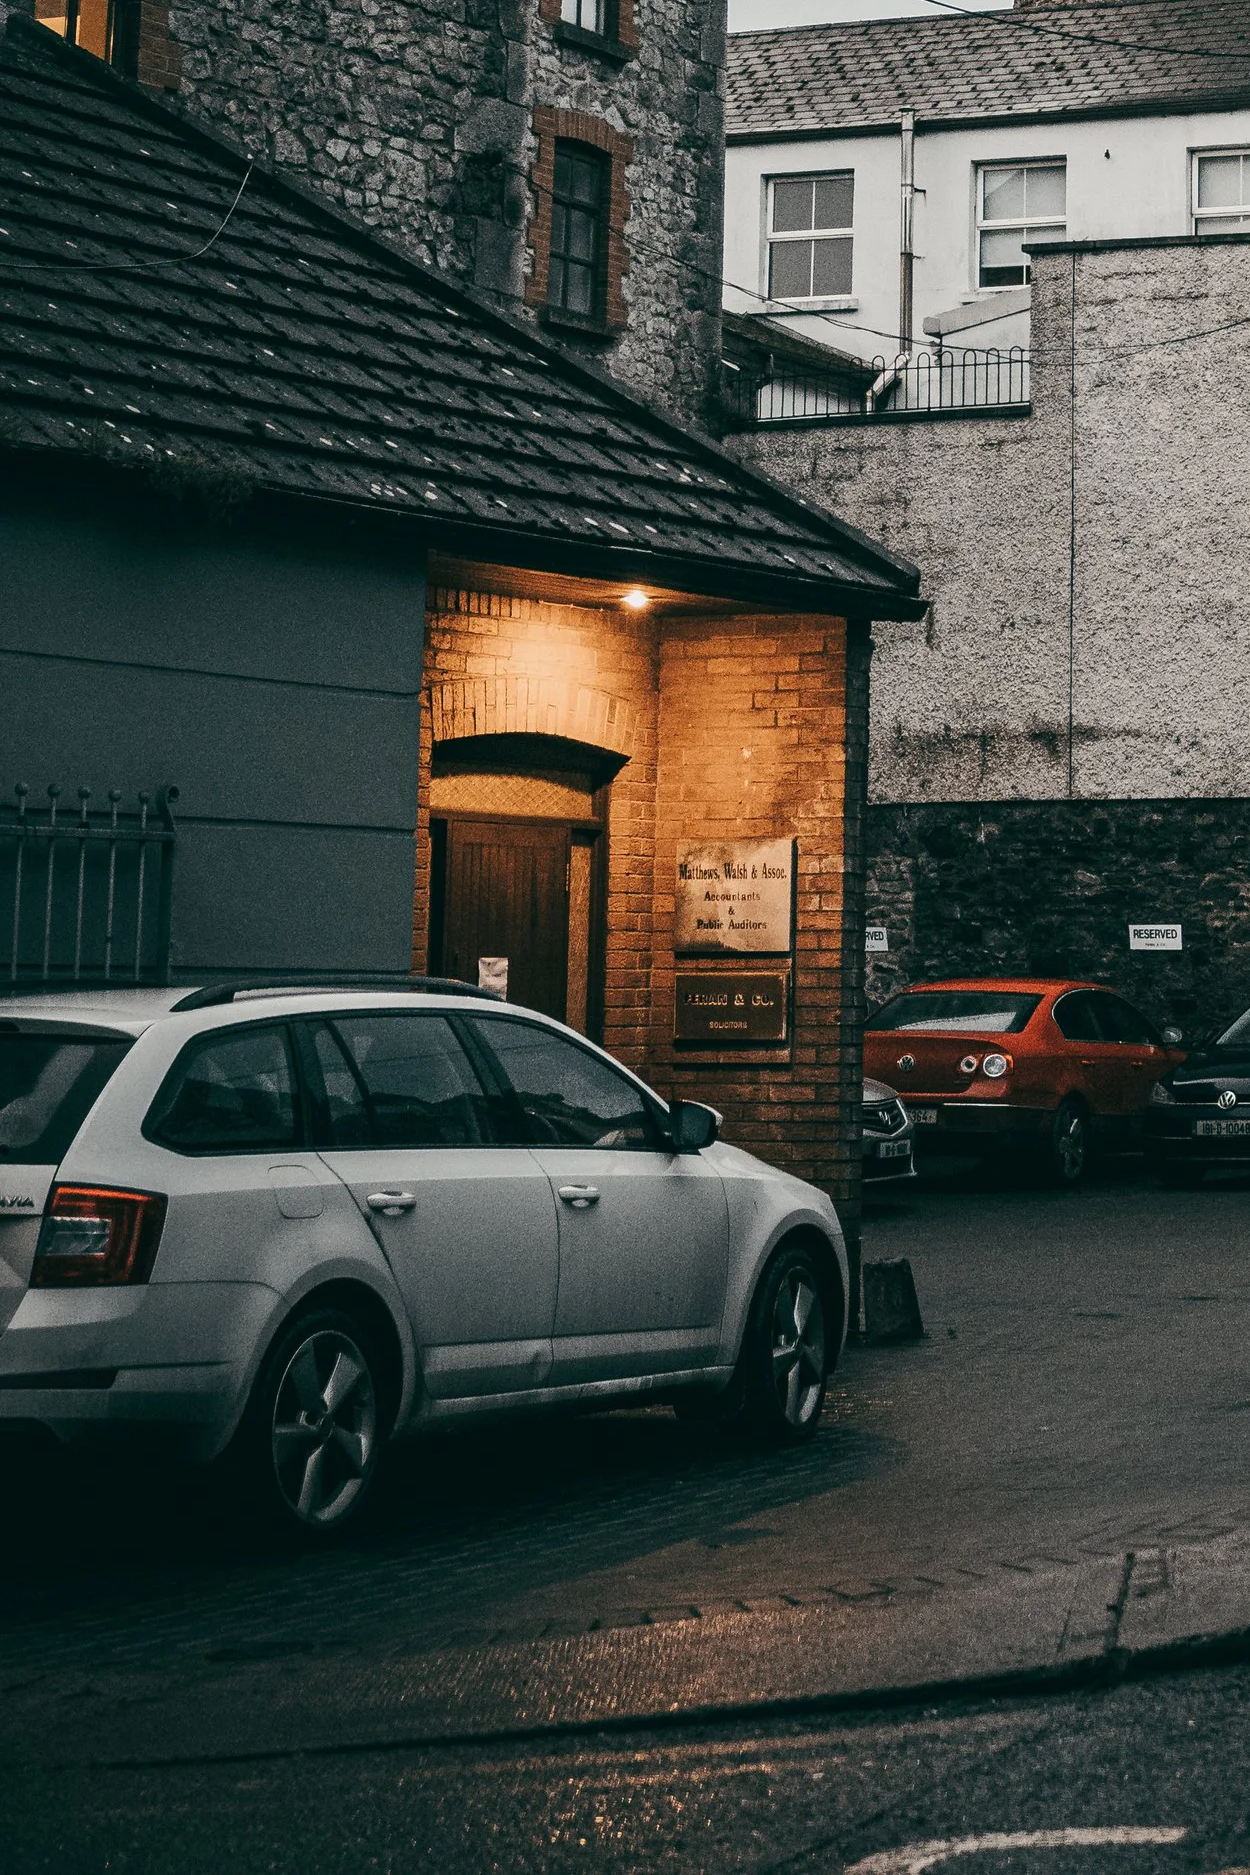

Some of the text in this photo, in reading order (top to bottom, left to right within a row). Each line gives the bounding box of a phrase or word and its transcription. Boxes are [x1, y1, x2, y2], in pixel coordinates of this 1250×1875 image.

[679, 862, 787, 882] Matthews, Walsh & Assoc.
[704, 891, 761, 902] Accountants
[729, 906, 735, 916] &
[696, 918, 767, 930] Public Auditors
[1133, 929, 1178, 939] RESERVED
[734, 993, 745, 1006] &
[751, 993, 774, 1006] CO.
[709, 1021, 748, 1029] SOLICITORS
